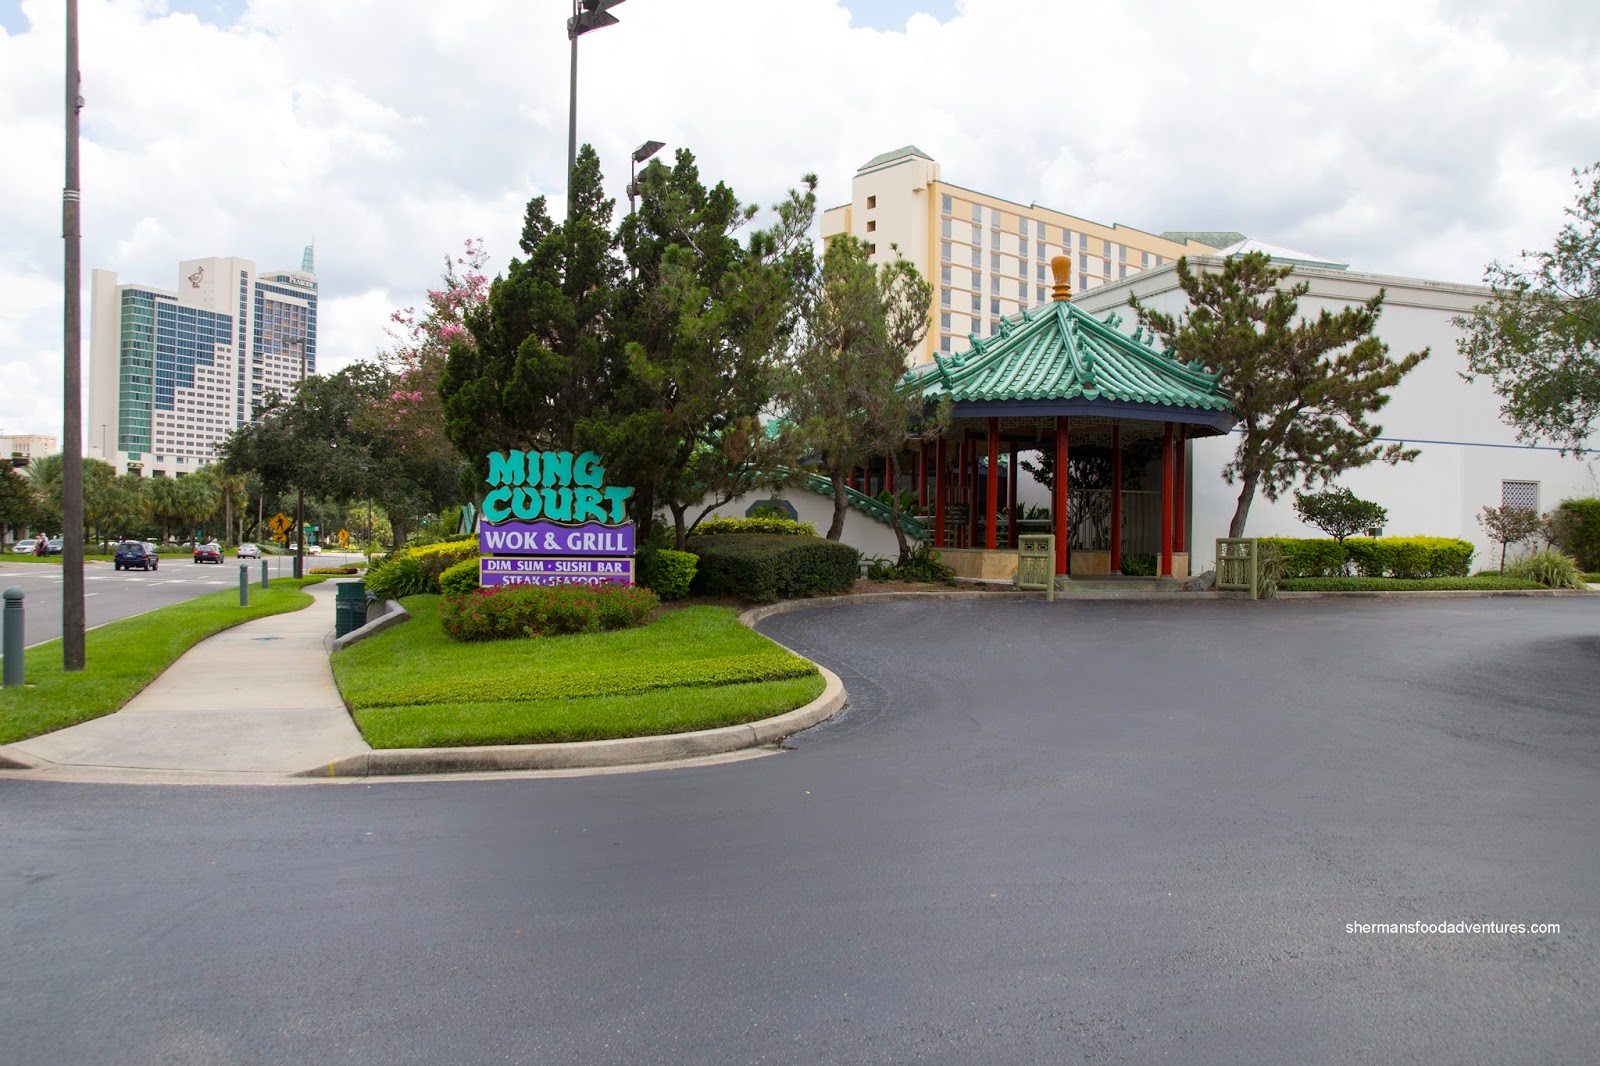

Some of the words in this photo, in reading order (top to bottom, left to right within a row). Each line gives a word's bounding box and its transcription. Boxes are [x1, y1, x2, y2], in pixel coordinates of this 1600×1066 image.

[486, 449, 606, 488] MING
[482, 485, 635, 524] COURT
[485, 531, 539, 550] WOK
[543, 531, 562, 550] &
[567, 532, 628, 551] GRILL
[487, 560, 512, 571] DIM
[517, 561, 544, 571] SUM
[555, 561, 592, 572] SUSHI
[597, 562, 623, 573] BAR
[502, 575, 541, 586] STEAK
